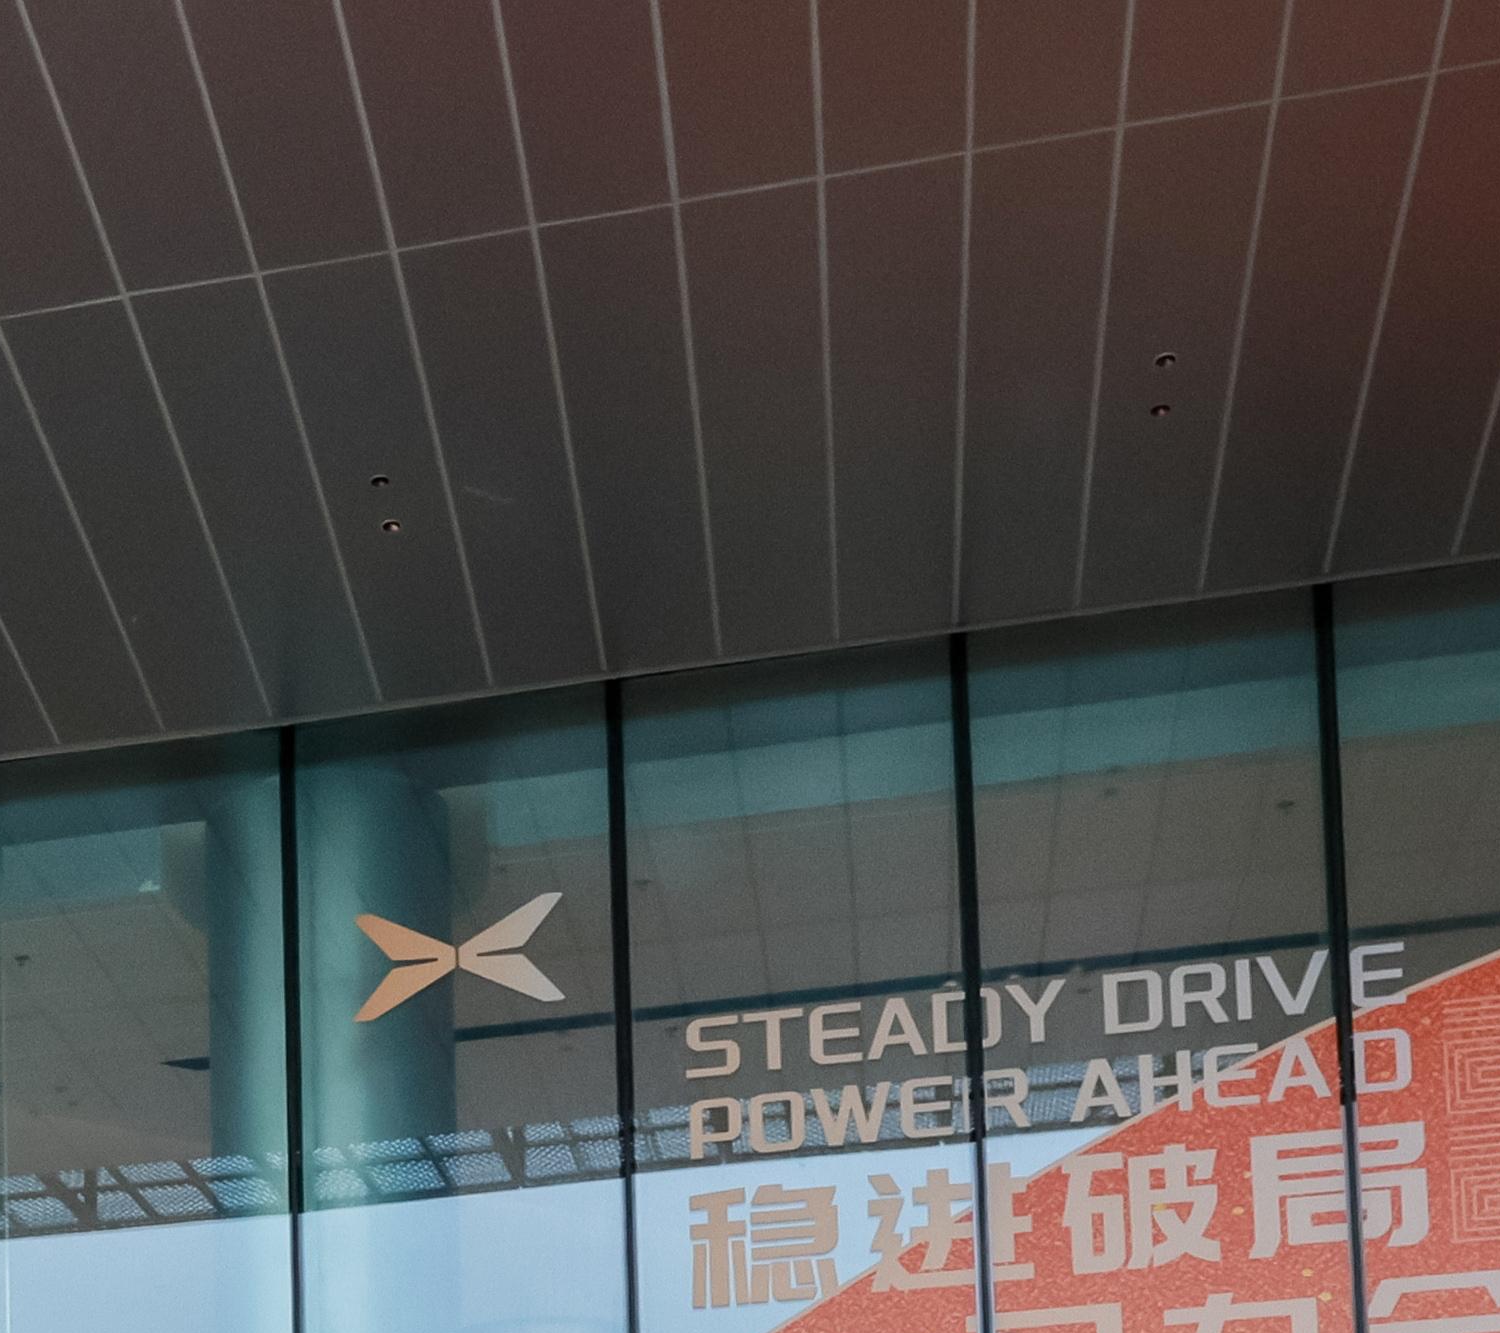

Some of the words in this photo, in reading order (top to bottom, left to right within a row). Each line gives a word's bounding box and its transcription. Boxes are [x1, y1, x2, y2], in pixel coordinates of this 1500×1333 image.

[686, 979, 1066, 1079] STEADY
[1102, 942, 1407, 1036] DRIVE
[690, 1067, 1031, 1161] POWER
[1070, 1028, 1413, 1123] AHEAD
[690, 1121, 1430, 1309] 稳进破局
